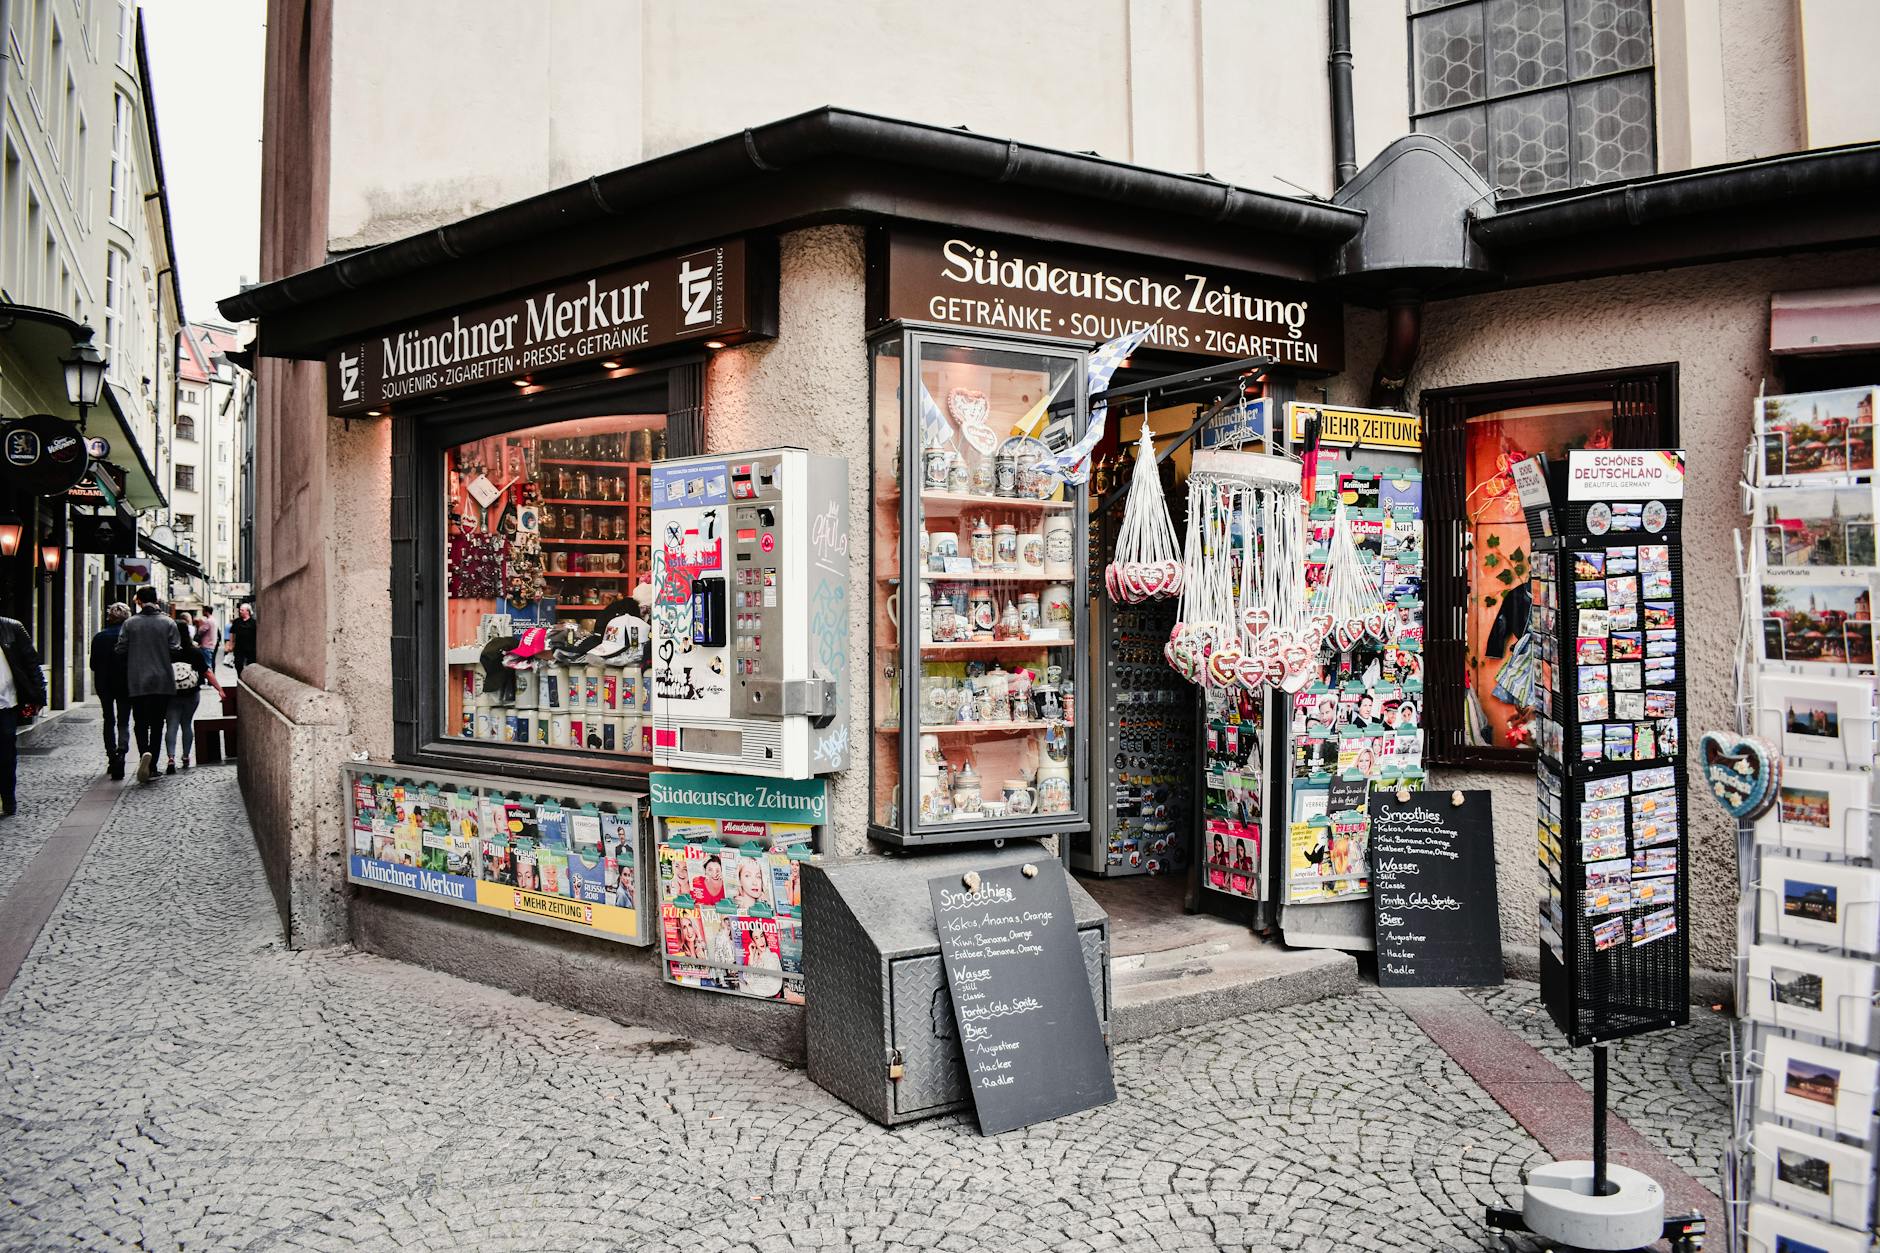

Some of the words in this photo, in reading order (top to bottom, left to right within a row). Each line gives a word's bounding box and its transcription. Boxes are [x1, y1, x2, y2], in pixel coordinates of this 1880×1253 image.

[716, 247, 724, 292] ZEITUNG
[678, 261, 714, 326] tz
[941, 239, 1181, 310] Süddeutsche
[1184, 273, 1308, 338] Zeitung
[382, 314, 519, 379] Münchner
[524, 278, 650, 346] Merkur
[929, 295, 1052, 333] GETRÄNKE
[1204, 329, 1319, 364] ZIGARETTEN
[382, 372, 438, 400] SOUVENIRS
[445, 355, 514, 386] ZIGARETTEN
[523, 342, 567, 369] PRESSE
[577, 324, 649, 357] GETRÄNKE
[339, 352, 360, 402] tz
[1362, 419, 1422, 442] ZEITUNG
[1594, 455, 1644, 466] SCHÖNES
[1575, 467, 1663, 480] DEUTSCHLAND
[1584, 481, 1620, 489] BEAUTIFUL
[1350, 521, 1383, 535] kicker
[1766, 568, 1811, 577] Kuvertkarte
[1296, 693, 1316, 706] Gala
[650, 783, 755, 807] Süddeutsche
[755, 786, 825, 817] Zeitung
[1378, 804, 1442, 822] Smoothies
[1433, 826, 1459, 839] Orange
[1424, 836, 1452, 850] Orange
[1434, 848, 1460, 860] Orange
[1378, 857, 1419, 871] Wasser
[361, 859, 417, 889] Münchner
[420, 870, 465, 899] Merkur
[940, 881, 1013, 907] Smoothies
[1430, 893, 1456, 910] Sprite
[523, 896, 547, 911] MEHR
[548, 900, 582, 918] ZEITUNG
[731, 918, 778, 933] emotion
[982, 912, 1024, 926] Ananas,
[1023, 911, 1054, 926] Orange
[1379, 912, 1404, 925] Bier
[1009, 930, 1034, 941] Orange
[1385, 931, 1427, 945] Augustiner
[1017, 944, 1045, 956] Orange
[952, 965, 991, 981] Wasser
[1012, 997, 1039, 1012] Sprite
[963, 1023, 988, 1038] Bier
[976, 1040, 1021, 1056] Augustiner
